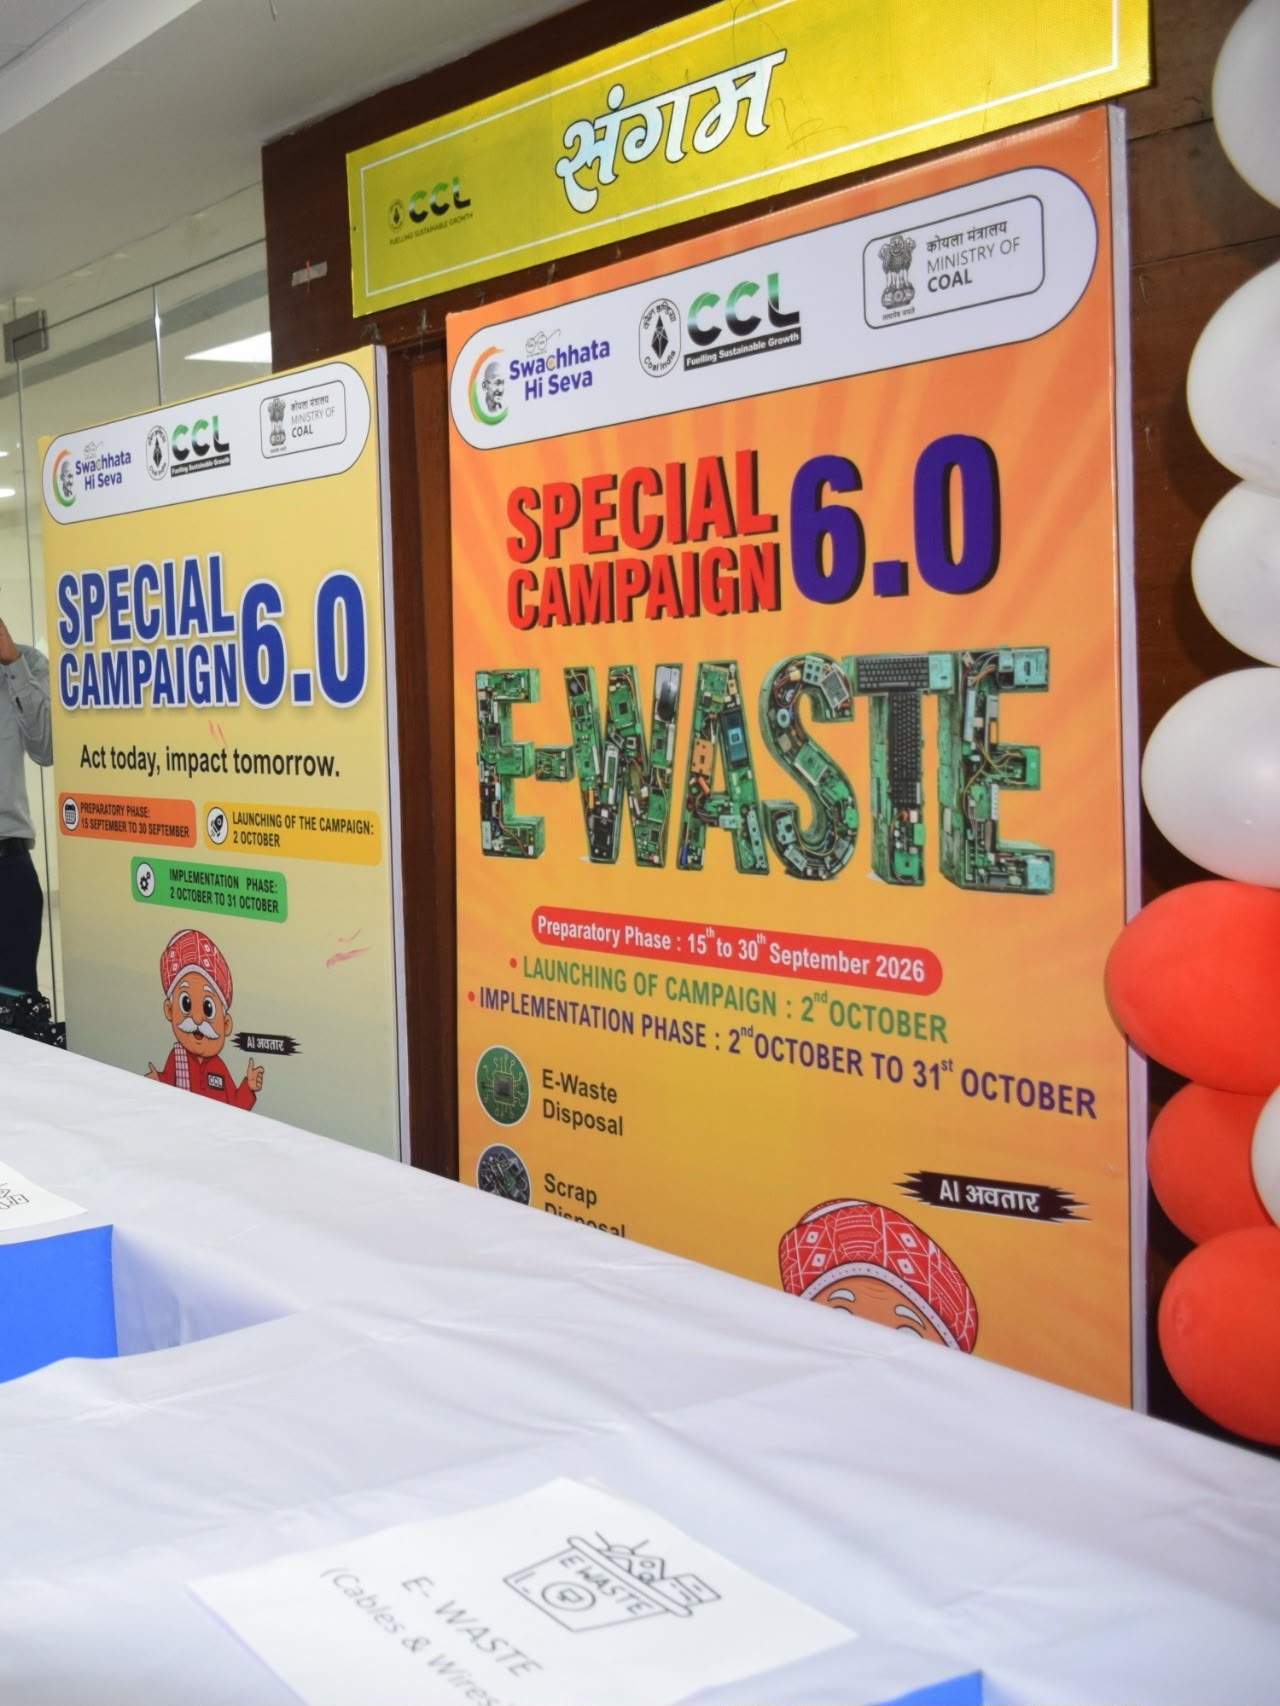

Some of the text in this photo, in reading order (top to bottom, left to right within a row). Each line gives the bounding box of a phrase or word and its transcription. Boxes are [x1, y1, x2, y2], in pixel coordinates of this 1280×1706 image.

[555, 48, 787, 214] संगम
[409, 176, 471, 223] CCL
[926, 221, 1007, 253] कोयला मंत्रालय
[927, 236, 1020, 273] MINISTRY OF
[927, 268, 973, 293] COAL
[688, 272, 800, 346] CCL
[509, 339, 610, 380] Swachhata
[644, 351, 676, 371] Coal India
[686, 332, 799, 367] Fuelling Sustainable Growth
[525, 370, 593, 401] Hi Seva
[291, 406, 336, 425] MINISTRY OF
[291, 424, 313, 438] COAL
[172, 415, 229, 461] CCL
[75, 451, 131, 475] Swachhata
[85, 472, 122, 491] Hi Seva
[505, 448, 777, 563] SPECIAL
[790, 433, 1002, 605] 6.0
[58, 554, 235, 646] SPECIAL
[506, 541, 780, 631] CAMPAIGN
[242, 573, 366, 706] 6.0
[59, 642, 238, 708] CAMPAIGN
[80, 744, 340, 778] Act today, impact tomorrow.
[474, 646, 1054, 895] E-WASTE
[80, 802, 150, 818] PREPARATORY PHASE:
[81, 818, 190, 838] 15 SEPTEMBER TO 30 SEPTEMBER
[232, 811, 374, 835] LAUNCHING OF THE CAMPAIGN:
[233, 830, 281, 848] 2 OCTOBER
[169, 868, 278, 894] IMPLEMENTATION PHASE:
[170, 886, 279, 914] 2 OCTOBER TO 31 OCTOBER
[537, 914, 620, 948] Preparatory
[624, 926, 671, 951] Phase
[717, 936, 732, 958] to
[769, 943, 870, 975] September
[875, 955, 925, 983] 2026
[523, 956, 627, 992] LAUNCHING
[633, 971, 658, 997] OF
[665, 975, 777, 1016] CAMPAIGN
[829, 999, 948, 1043] OCTOBER
[247, 1036, 284, 1052] AI अवतार
[480, 986, 634, 1035] IMPLEMENTATION
[642, 1013, 707, 1048] PHASE
[754, 1032, 863, 1077] OCTOBER
[871, 1052, 903, 1083] TO
[961, 1068, 1098, 1120] OCTOBER
[209, 1075, 222, 1087] CCL
[542, 1068, 617, 1104] E-Waste
[543, 1099, 623, 1136] Disposal
[544, 1173, 597, 1209] Scrap
[939, 1179, 1040, 1213] AI अवतार
[576, 1567, 653, 1615] WASTE
[320, 1567, 405, 1635] (Cables
[401, 1636, 431, 1654] &
[435, 1600, 544, 1677] WASTE
